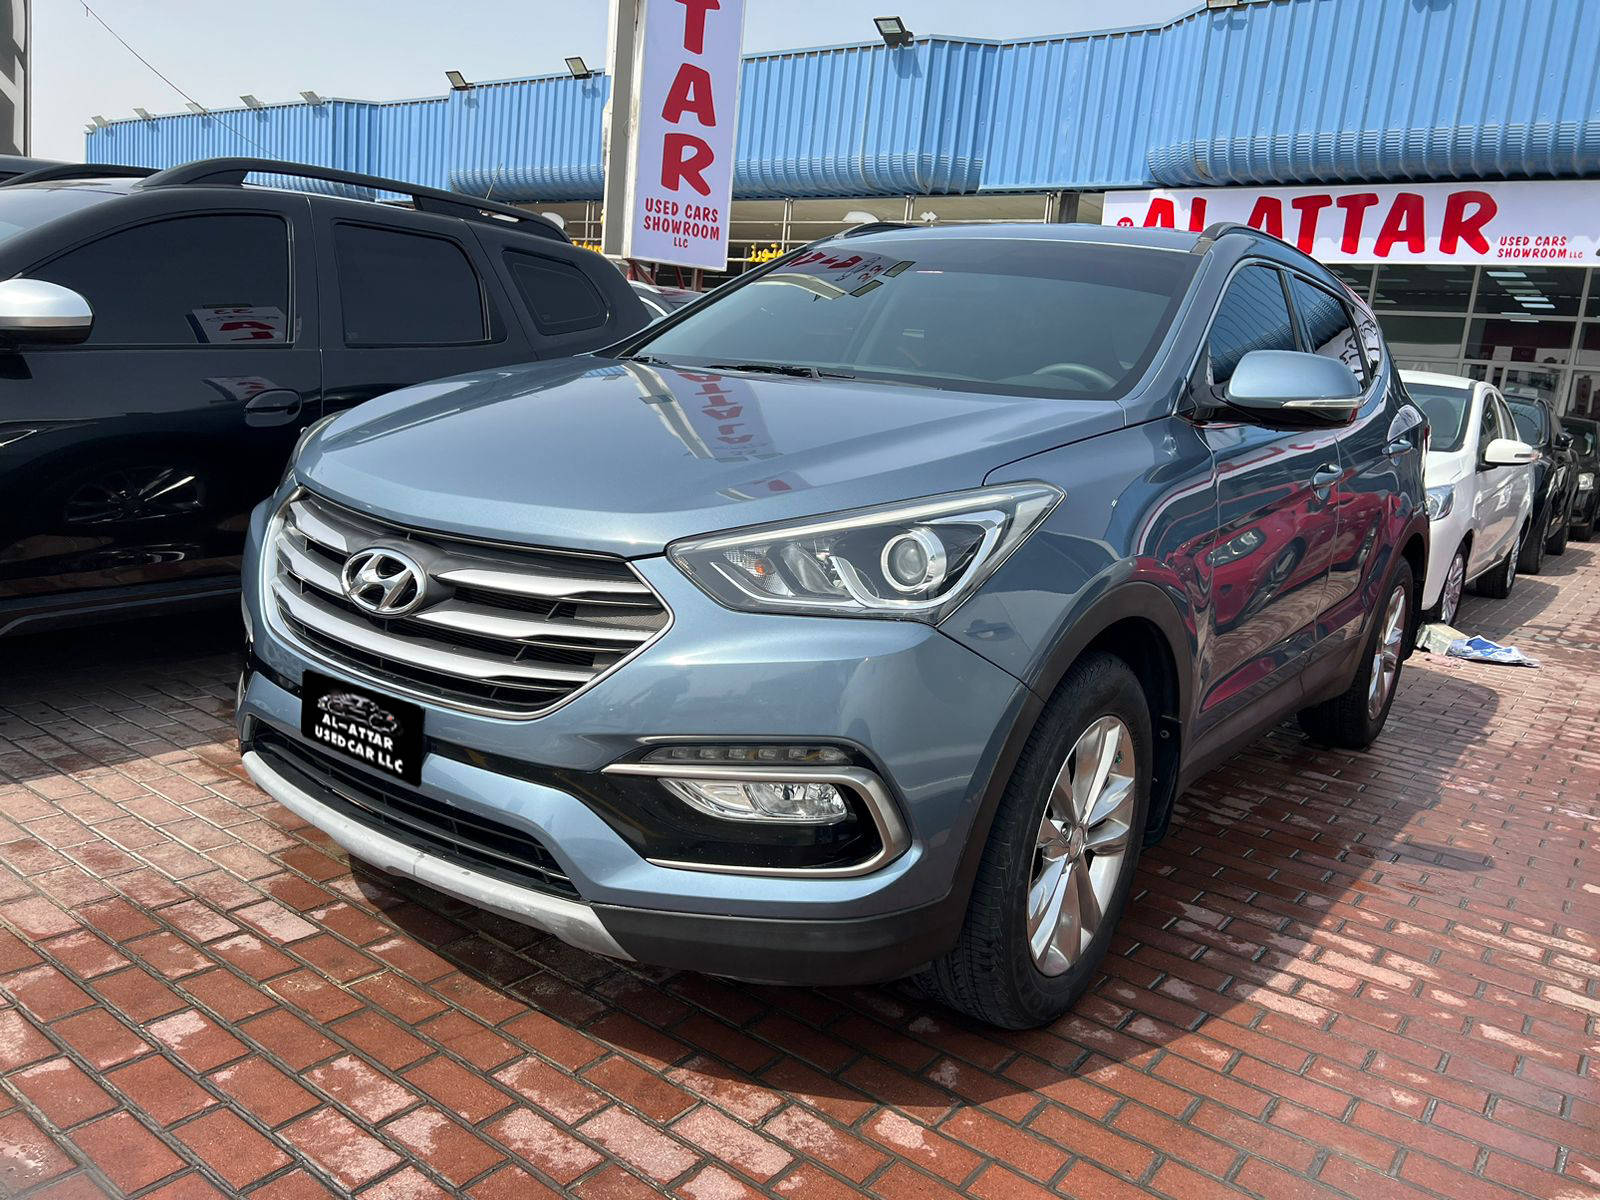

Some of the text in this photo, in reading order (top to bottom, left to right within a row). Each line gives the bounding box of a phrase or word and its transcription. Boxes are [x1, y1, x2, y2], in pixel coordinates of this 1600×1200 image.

[645, 197, 719, 223] USED CARS
[643, 215, 720, 241] SHOWROOM
[1247, 190, 1498, 257] ATTAR
[673, 237, 689, 248] LLC
[1497, 247, 1567, 259] SHOWROOM
[1500, 236, 1567, 246] USED CARS
[321, 713, 394, 752] AL-ATTAR
[315, 724, 403, 774] USED CAR LLC
